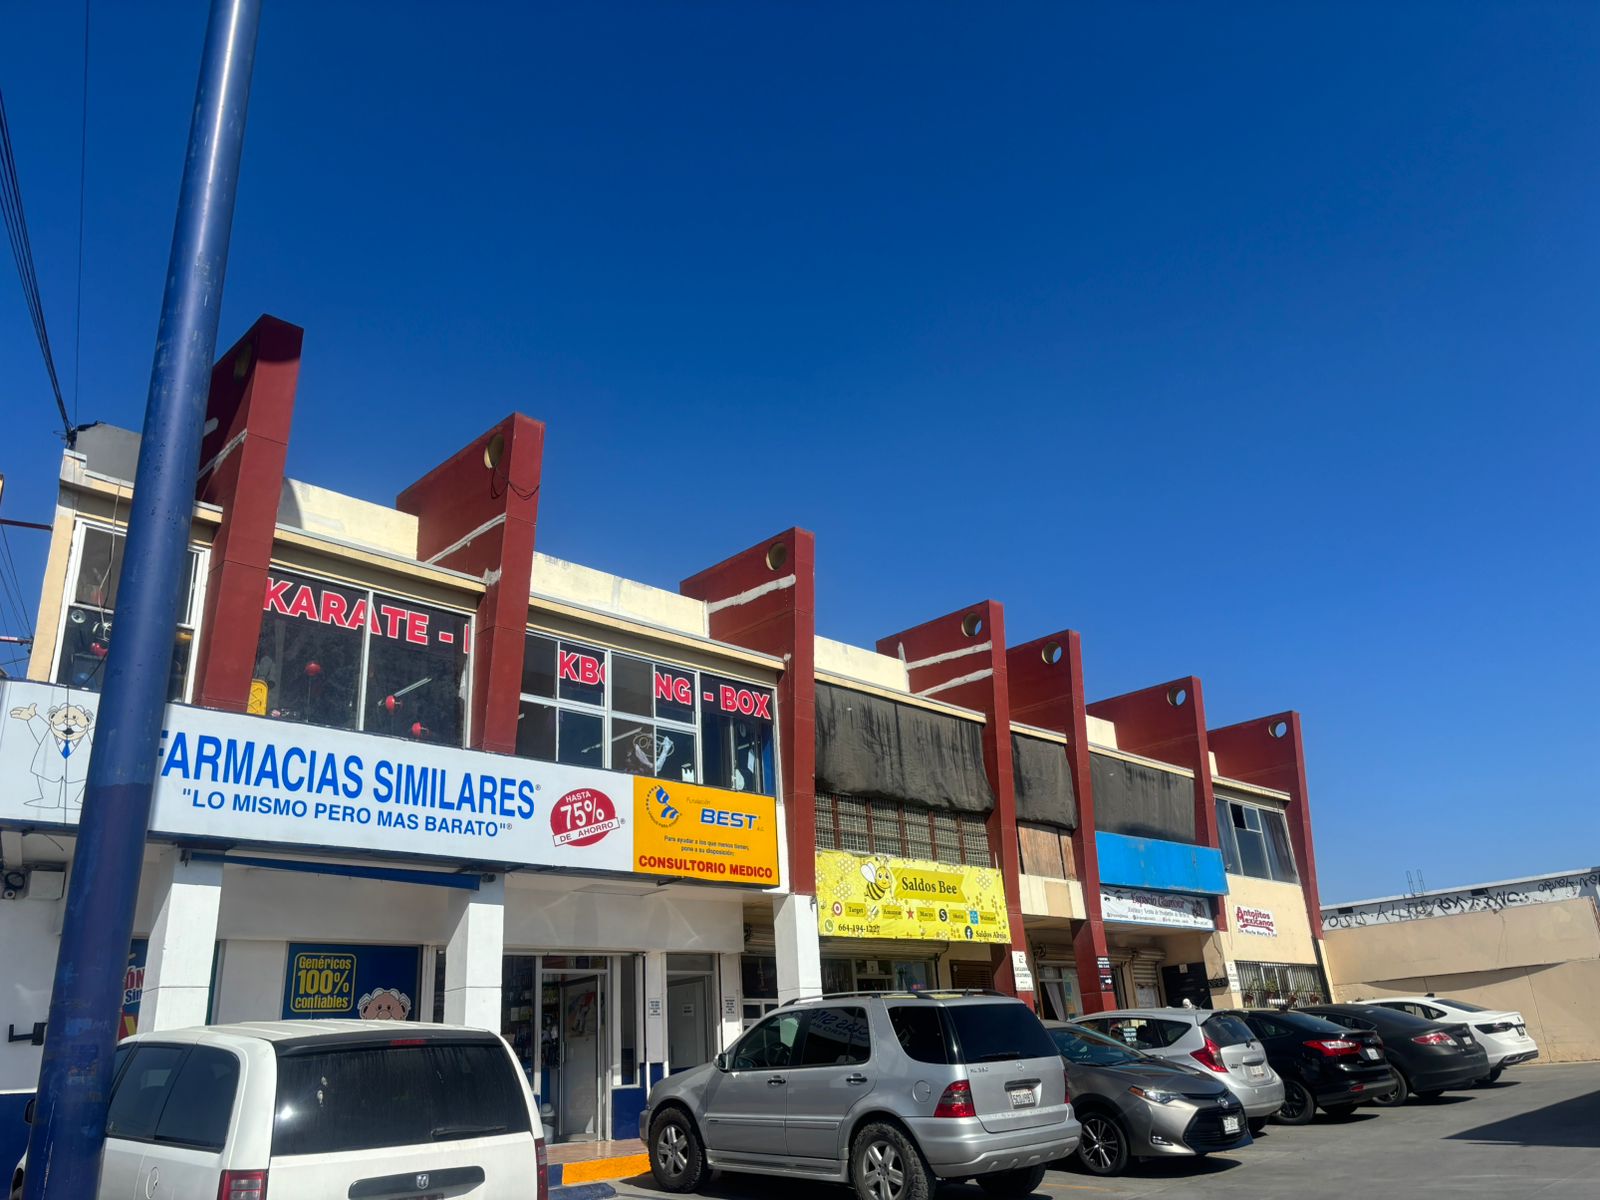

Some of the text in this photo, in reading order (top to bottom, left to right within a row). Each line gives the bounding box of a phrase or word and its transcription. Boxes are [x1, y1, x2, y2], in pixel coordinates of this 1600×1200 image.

[263, 577, 429, 645] KARATE
[559, 650, 605, 685] KB
[720, 684, 771, 720] BOX
[565, 791, 592, 803] HASTA
[232, 794, 307, 818] MISMO
[314, 803, 371, 824] PERO
[377, 811, 419, 830] MAS
[560, 797, 605, 830] 75%
[700, 808, 757, 830] BEST
[560, 821, 614, 842] DE AHORRO
[638, 855, 773, 879] CONSULTORIO MEDICO
[901, 877, 958, 895] Saldos Bee
[299, 955, 352, 970] Genéricos
[298, 969, 349, 995] 100%
[295, 995, 349, 1009] confiables
